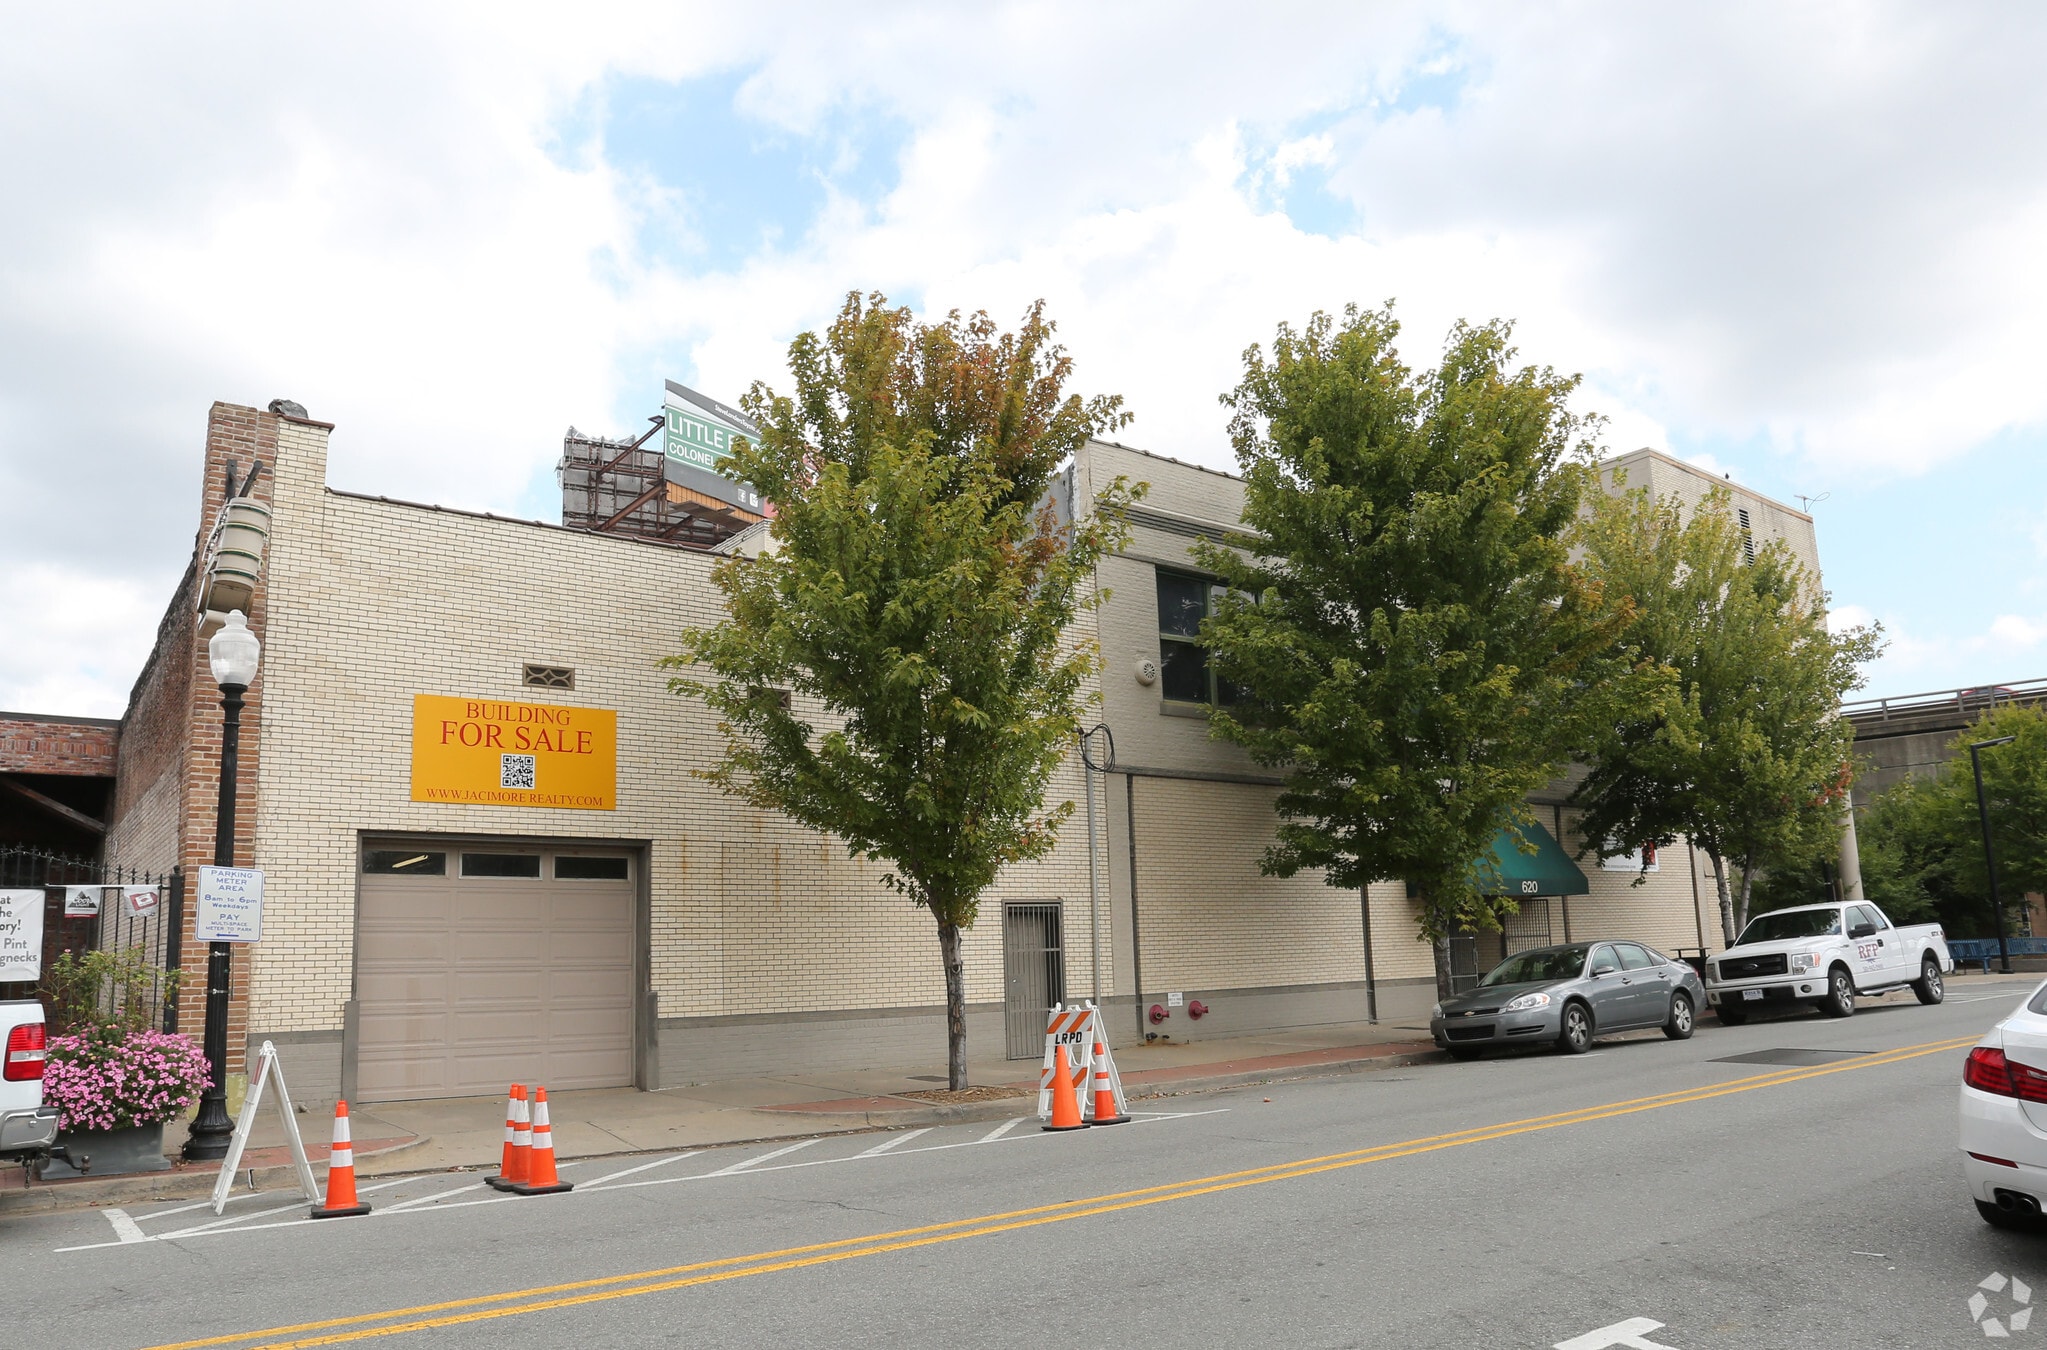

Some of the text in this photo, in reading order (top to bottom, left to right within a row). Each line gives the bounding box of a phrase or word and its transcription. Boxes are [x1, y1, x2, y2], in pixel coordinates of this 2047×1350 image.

[669, 412, 723, 449] LITTLE
[669, 442, 716, 466] COLONEL
[466, 702, 571, 726] BUILDING
[440, 720, 594, 754] FOR SALE
[211, 869, 253, 879] PARKING
[1522, 880, 1538, 893] 620
[239, 896, 257, 904] 6pm
[4, 938, 27, 949] Pint
[1858, 943, 1879, 959] RFP
[1055, 1031, 1082, 1045] LRPD
